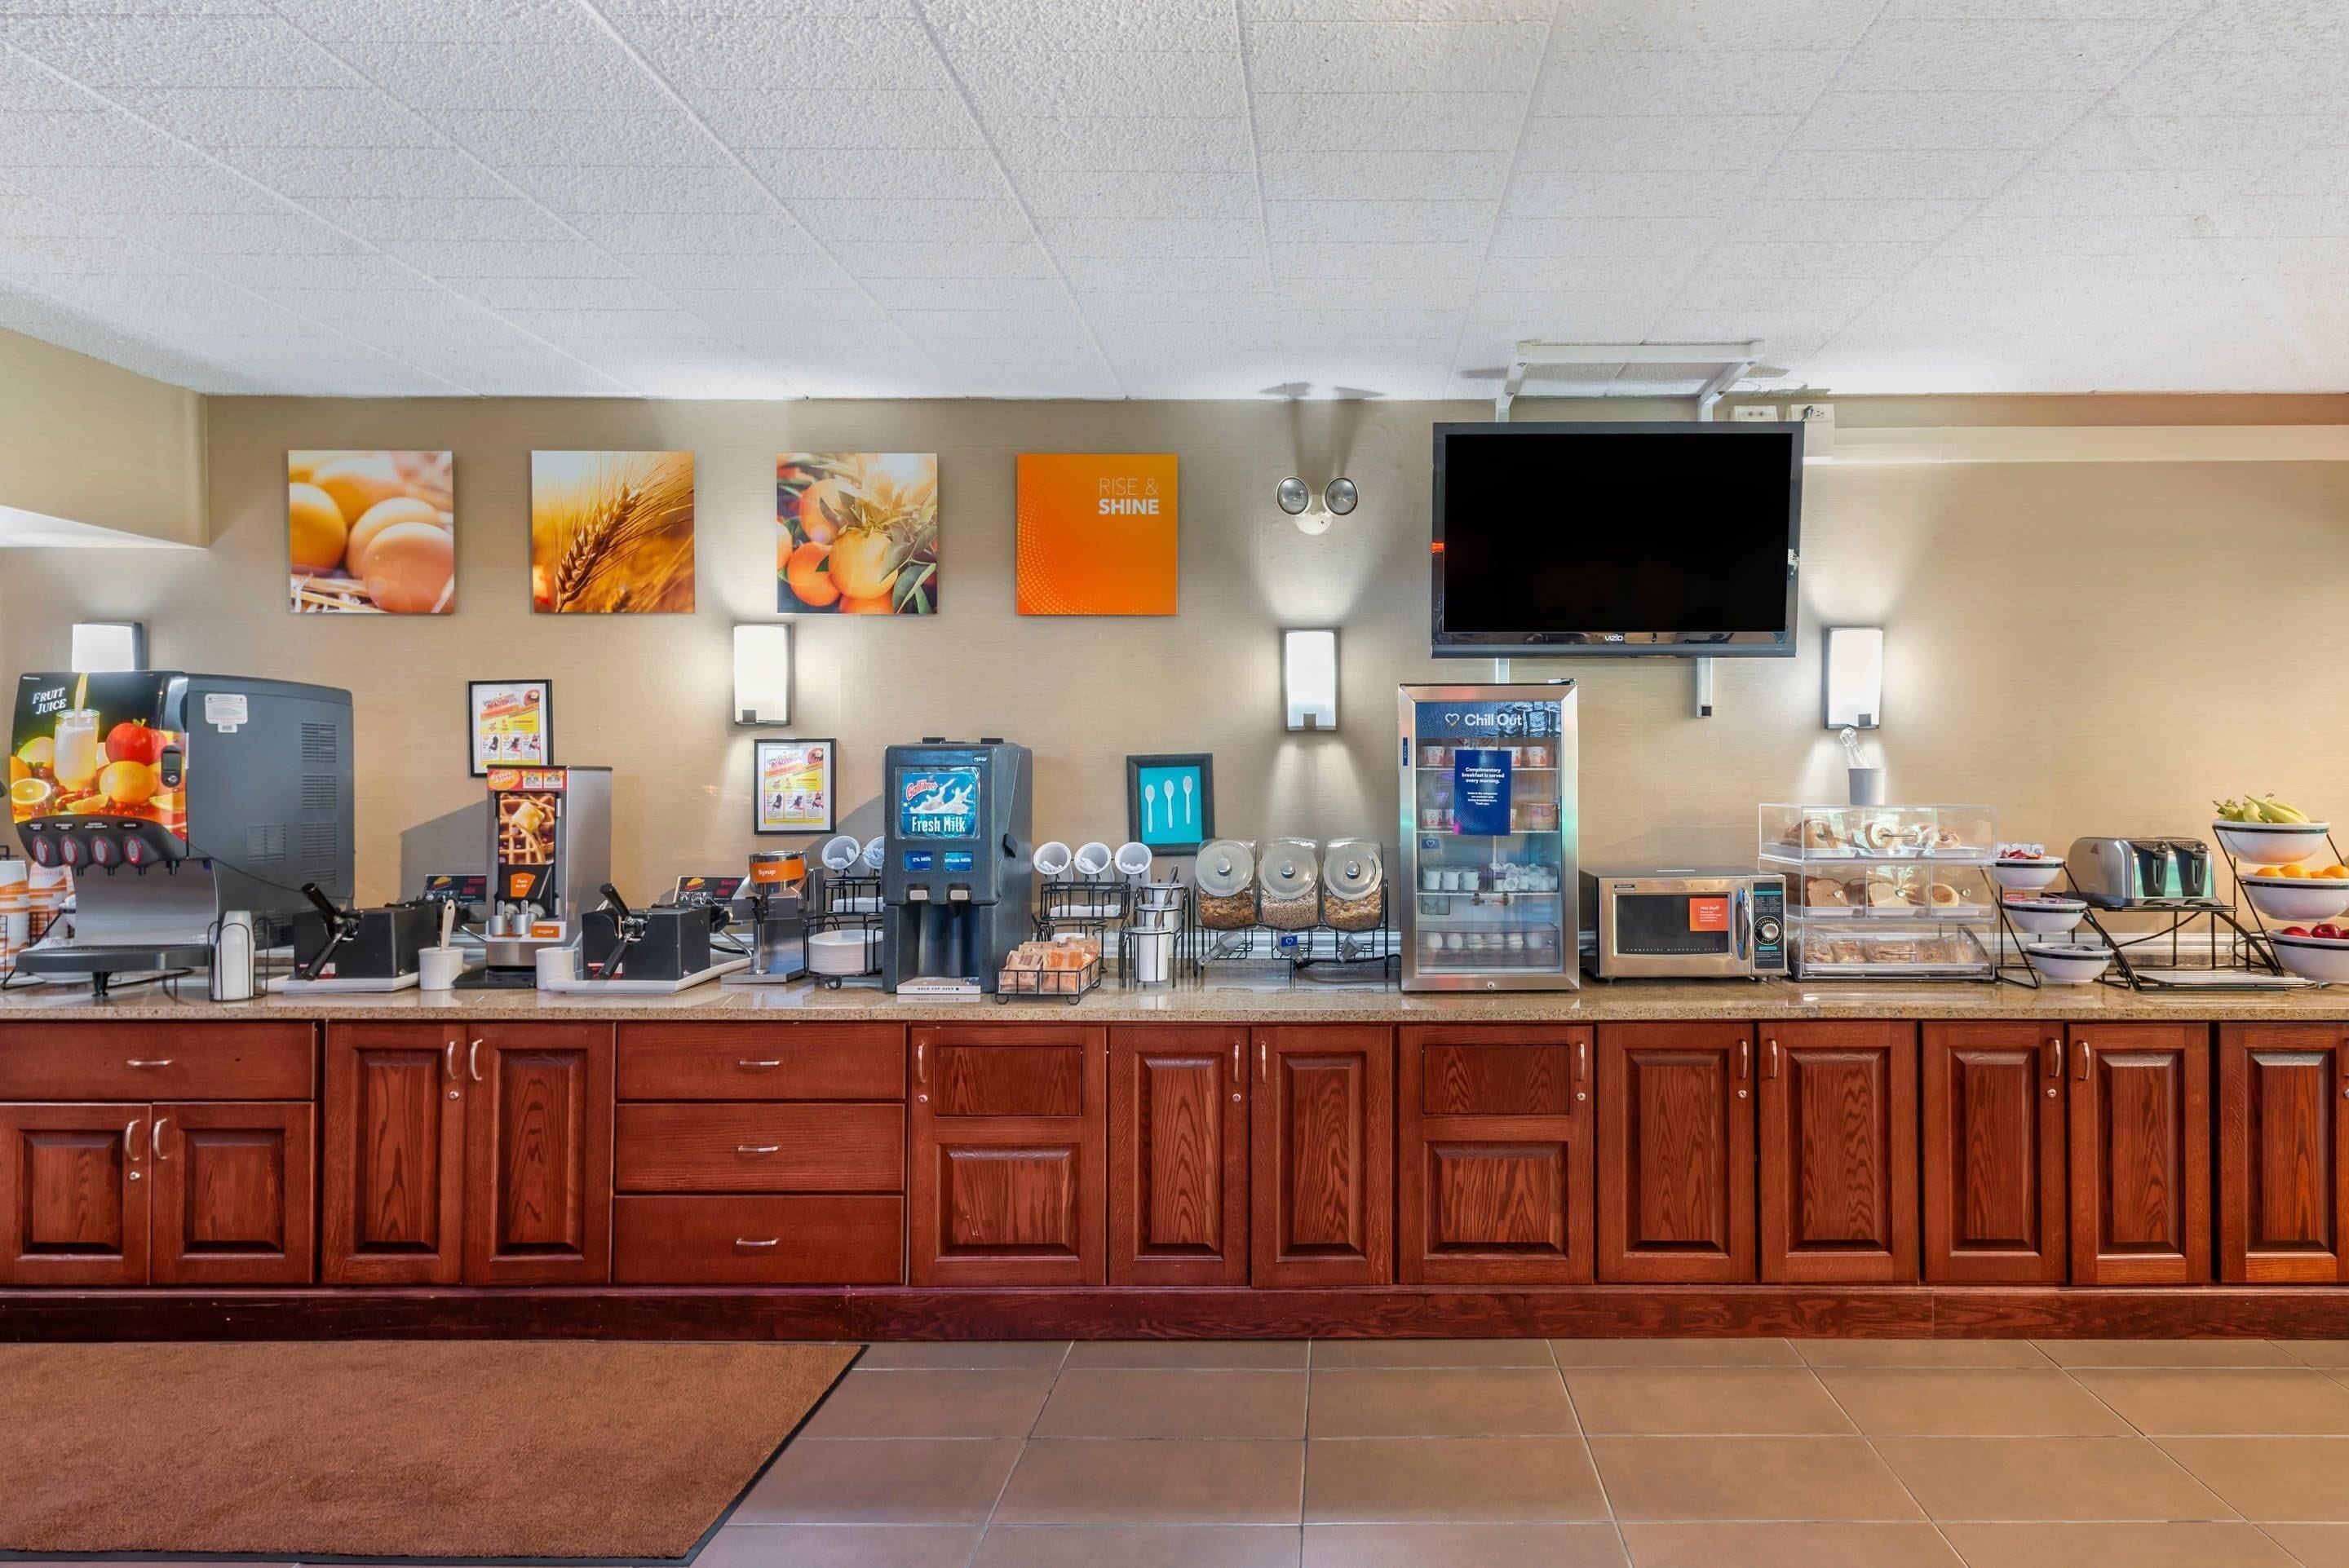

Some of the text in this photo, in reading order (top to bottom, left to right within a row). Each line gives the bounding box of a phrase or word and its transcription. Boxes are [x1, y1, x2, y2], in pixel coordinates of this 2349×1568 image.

[1099, 478, 1159, 496] RISE &
[1099, 498, 1160, 515] SHINE
[1604, 634, 1623, 642] VIZIO
[32, 687, 66, 704] FRUIT
[36, 699, 67, 715] JUICE
[1465, 713, 1523, 727] Chill Out
[912, 816, 966, 833] Fresh Milk
